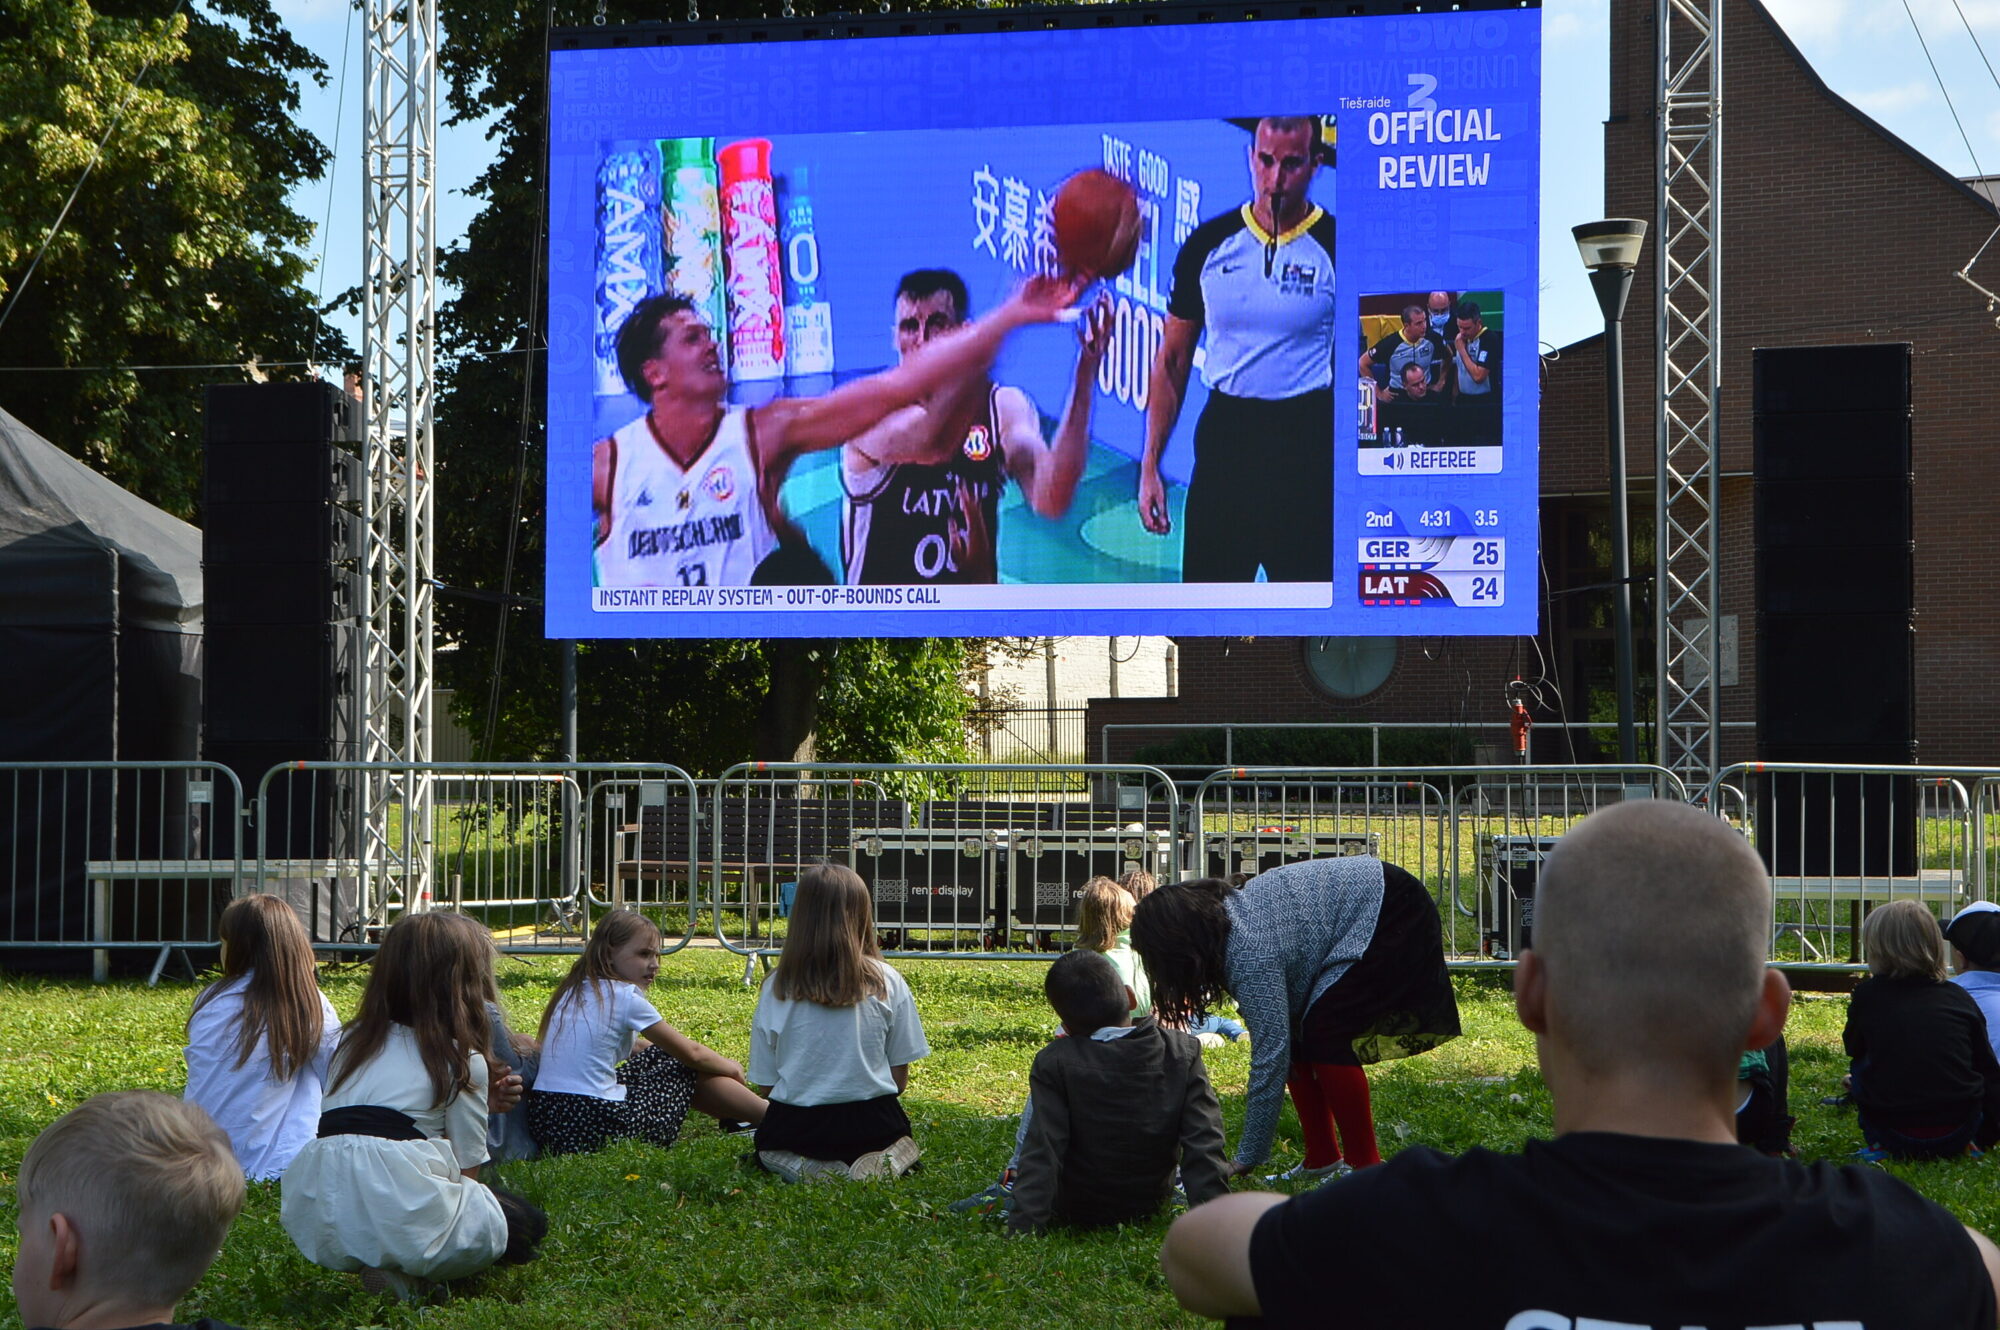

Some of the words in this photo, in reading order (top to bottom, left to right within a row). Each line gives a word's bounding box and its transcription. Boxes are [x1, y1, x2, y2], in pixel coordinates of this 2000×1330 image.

[1339, 96, 1391, 109] Tiešraide
[1368, 108, 1501, 145] OFFICIAL
[1102, 134, 1132, 183] TASTE
[1138, 149, 1168, 198] GOOD
[1379, 153, 1490, 189] REVIEW
[1410, 450, 1476, 468] REFEREE
[1366, 511, 1393, 527] 2nd
[1420, 510, 1451, 527] 4:31
[1475, 509, 1499, 526] 3.5
[1366, 541, 1410, 558] GER
[1473, 542, 1499, 565] 25
[600, 590, 658, 606] INSTANT
[662, 589, 714, 606] REPLAY
[718, 589, 773, 605] SYSTEM
[786, 588, 903, 605] OUT-OF-BOUNDS
[906, 588, 941, 604] CALL
[1365, 576, 1409, 594] LAT
[1472, 577, 1499, 600] 24
